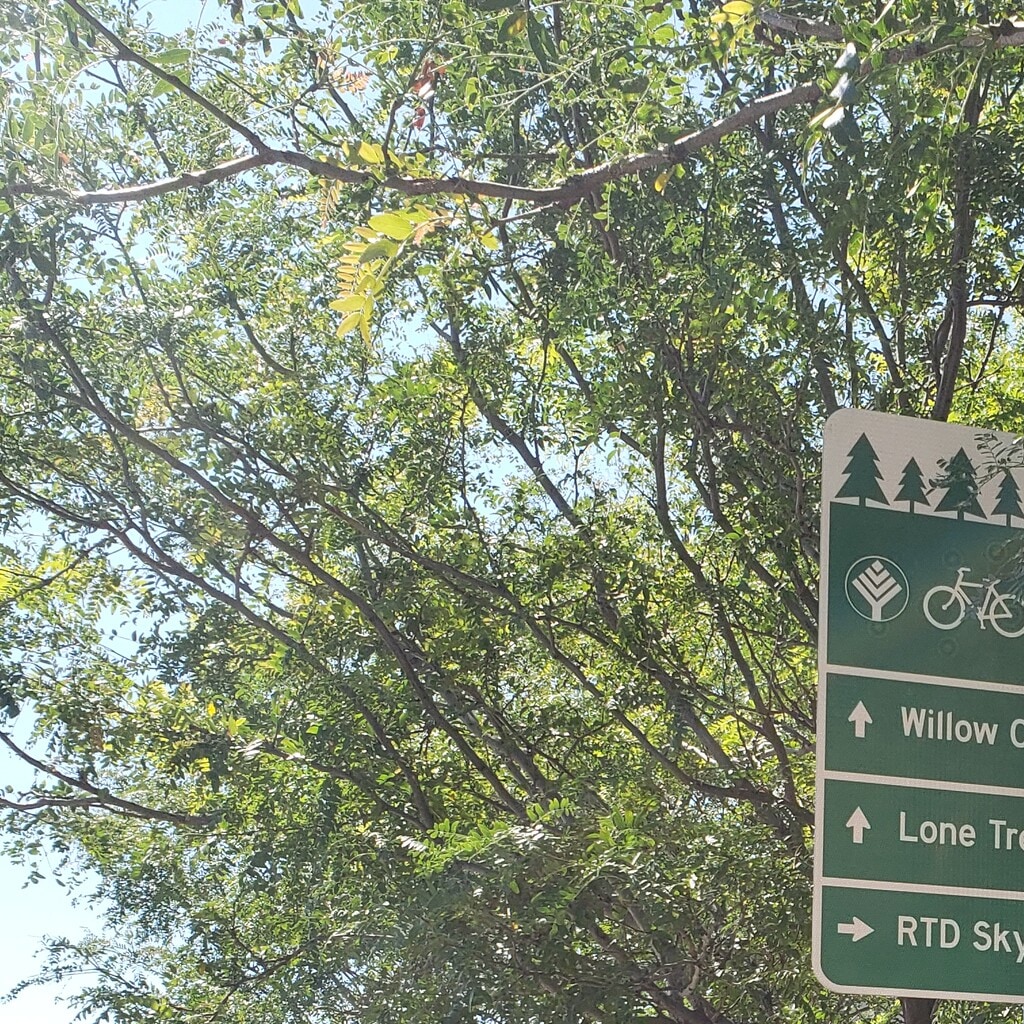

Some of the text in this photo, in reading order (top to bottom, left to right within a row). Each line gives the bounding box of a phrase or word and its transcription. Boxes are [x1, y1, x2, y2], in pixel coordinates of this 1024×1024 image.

[901, 706, 998, 745] Willow
[900, 811, 976, 847] Lone
[898, 916, 961, 949] RTD
